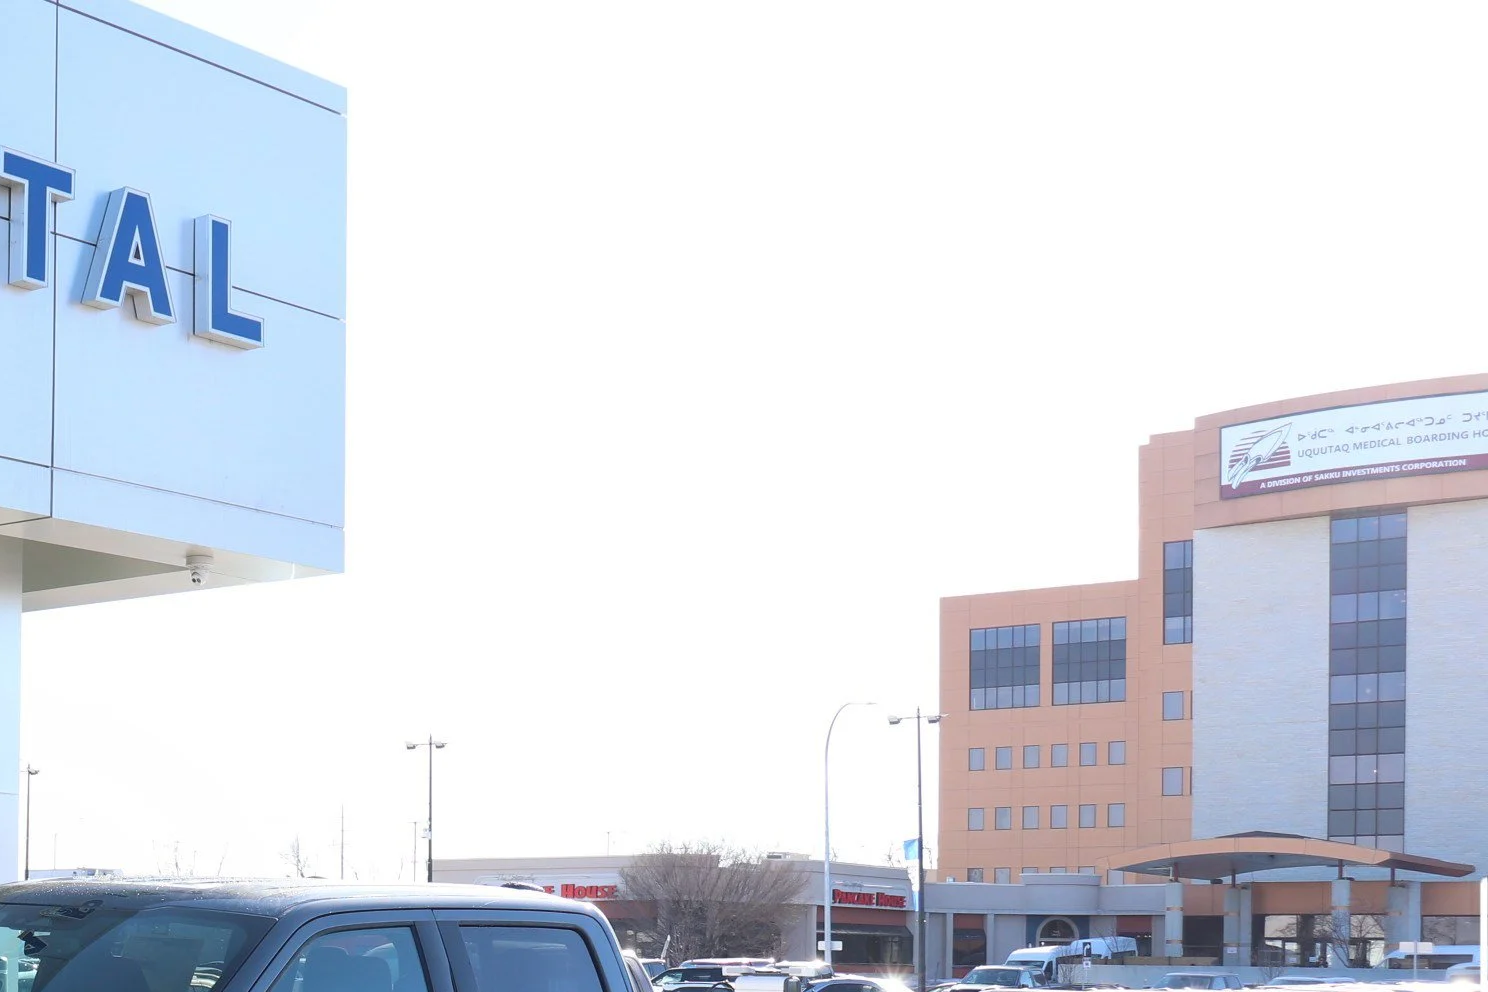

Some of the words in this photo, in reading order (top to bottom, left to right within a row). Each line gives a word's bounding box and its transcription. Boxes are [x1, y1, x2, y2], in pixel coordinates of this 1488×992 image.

[1298, 443, 1350, 458] UQUUTAQ
[1353, 437, 1401, 451] MEDICAL
[1407, 430, 1469, 445] BOARDING
[1267, 476, 1301, 488] DIVISION
[1302, 475, 1313, 483] OF
[1314, 470, 1341, 481] SAKKU
[1342, 464, 1400, 477] INVESTMENTS
[1401, 459, 1467, 472] CORPORATION
